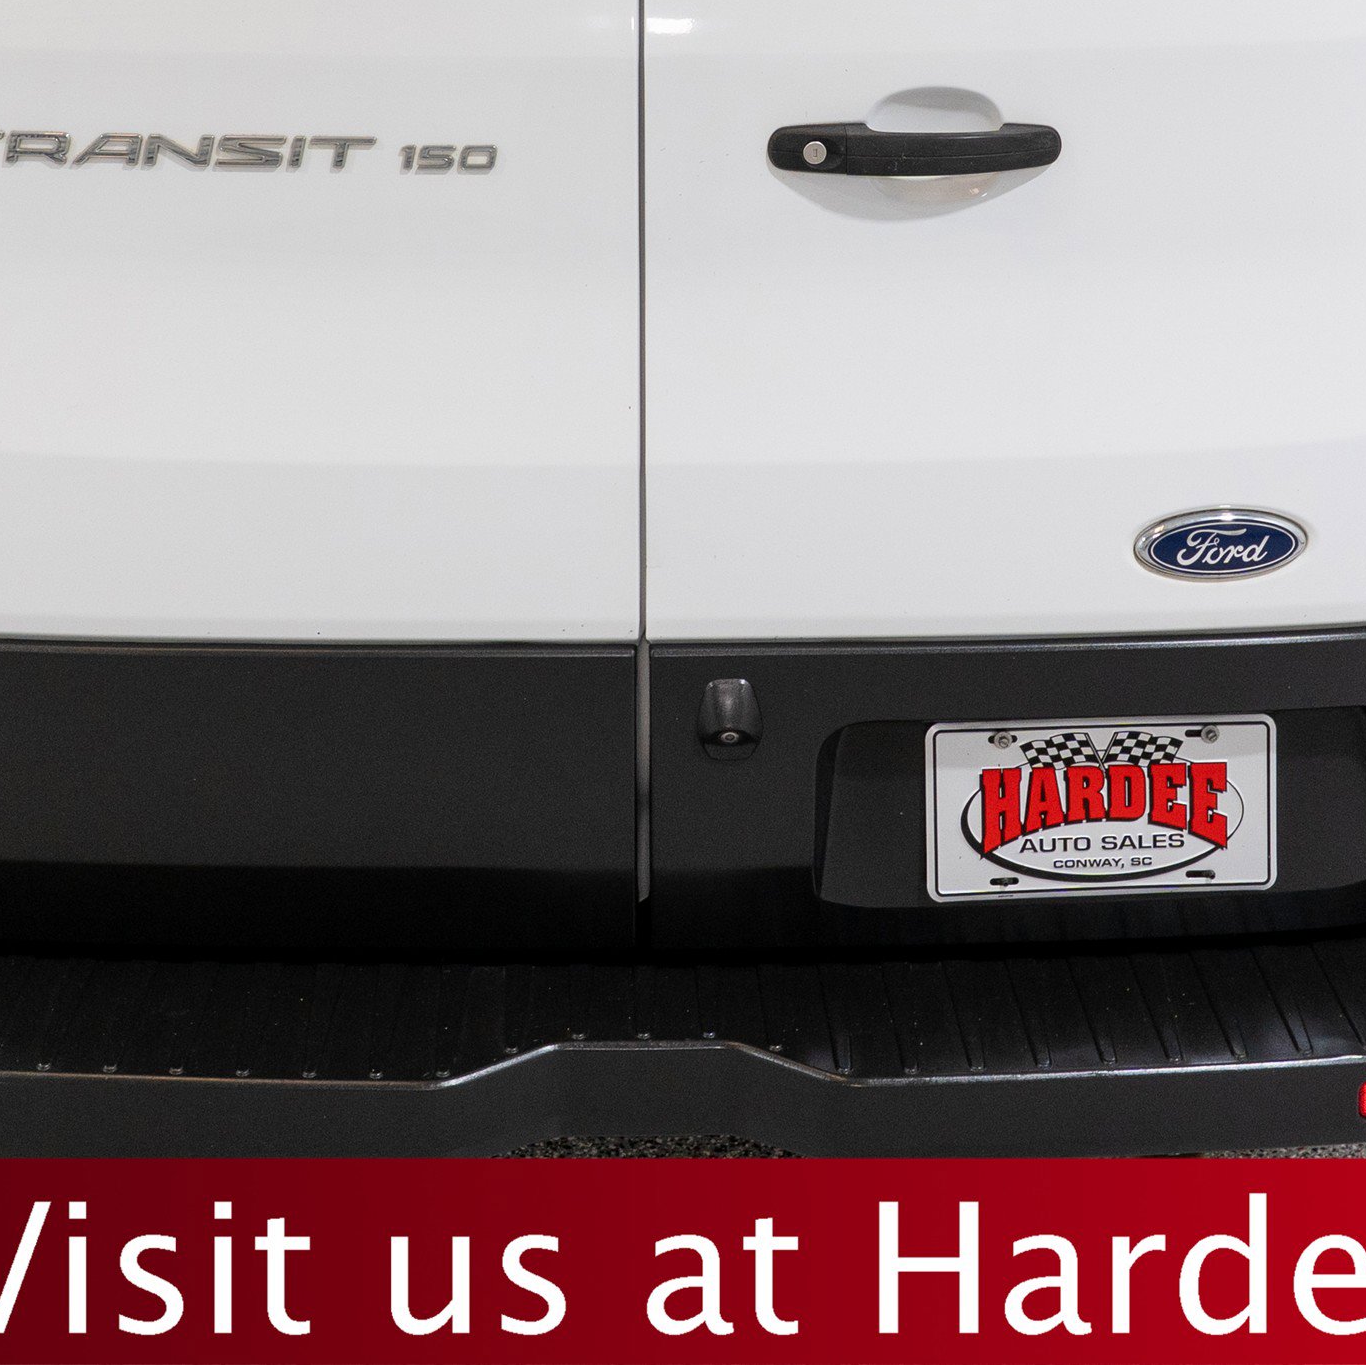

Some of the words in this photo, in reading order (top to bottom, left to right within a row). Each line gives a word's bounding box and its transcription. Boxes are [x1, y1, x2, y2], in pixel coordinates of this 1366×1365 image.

[400, 144, 498, 171] 150
[1176, 528, 1269, 566] Ford
[981, 762, 1228, 857] HARDEE
[1019, 837, 1091, 853] AUTO
[1101, 833, 1185, 851] SALES
[1053, 858, 1125, 869] CONWAY,
[1130, 856, 1153, 867] SC
